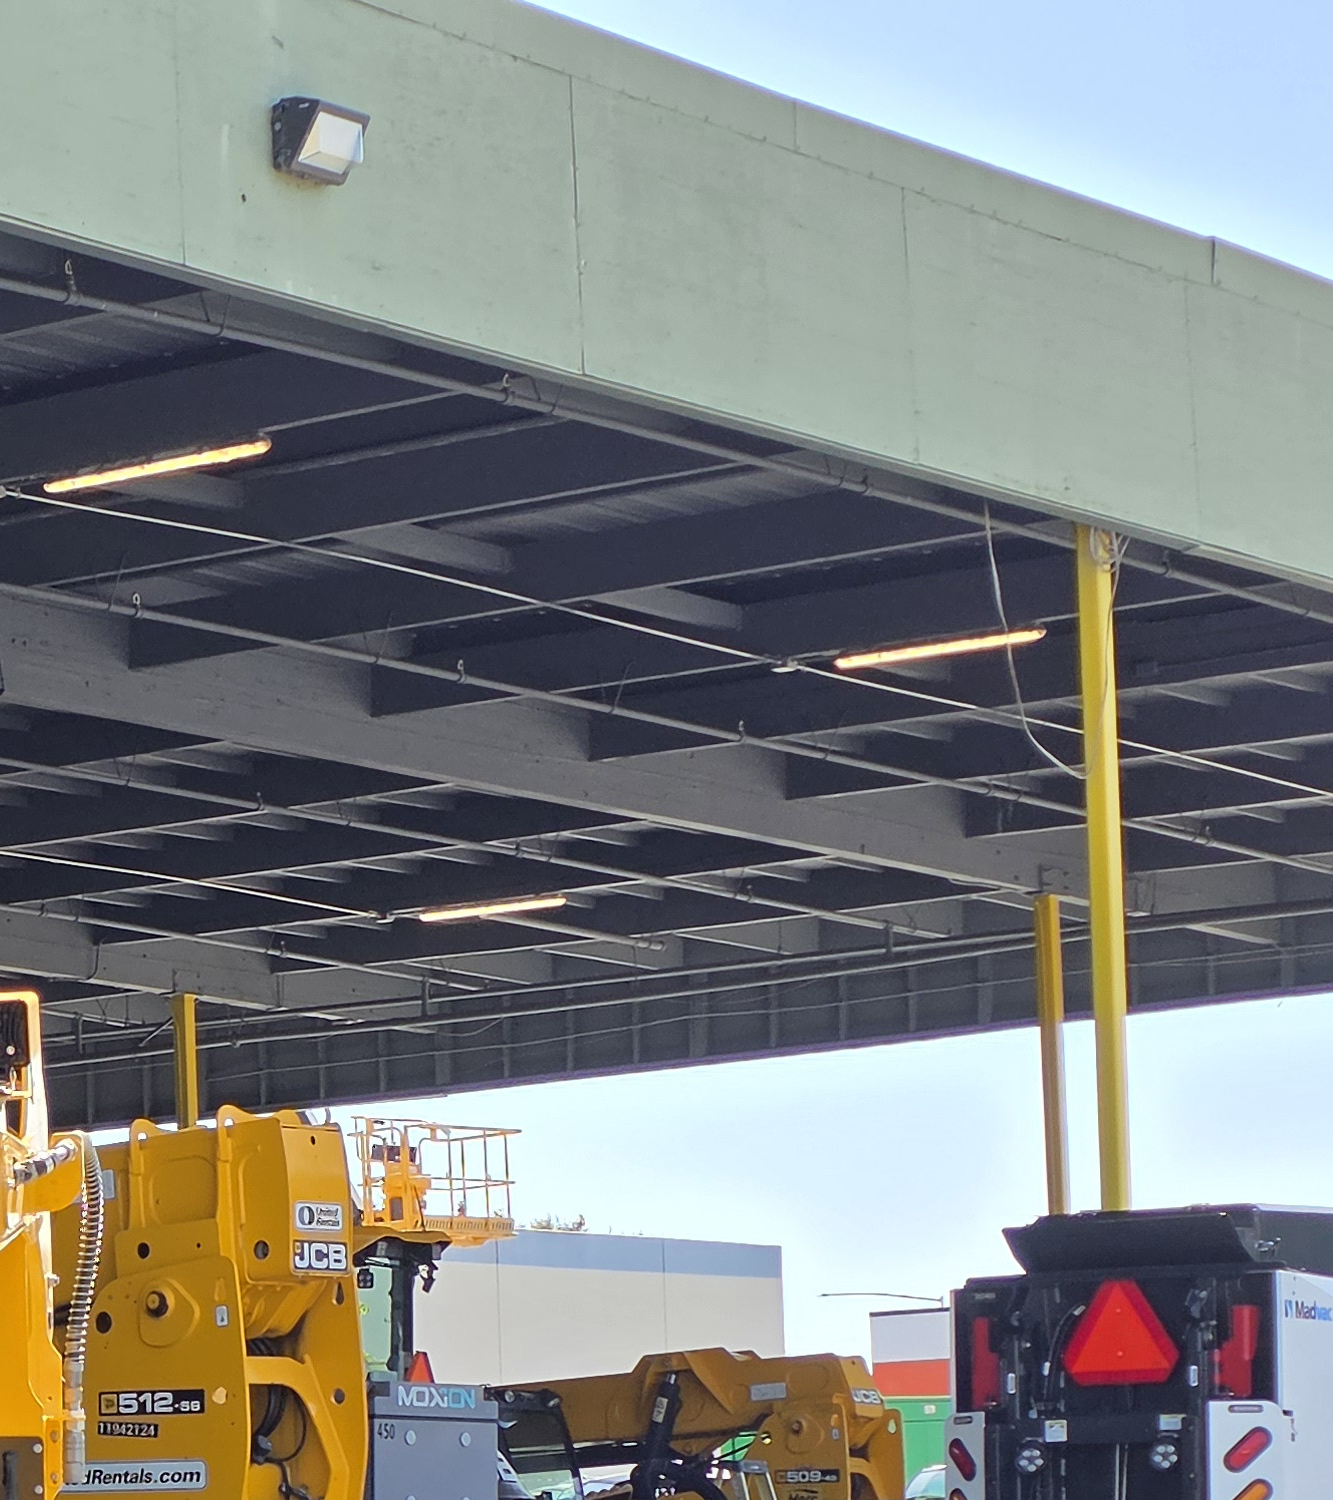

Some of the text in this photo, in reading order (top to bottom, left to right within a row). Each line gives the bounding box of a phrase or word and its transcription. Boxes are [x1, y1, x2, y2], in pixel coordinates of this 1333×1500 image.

[294, 1242, 347, 1270] JCB
[397, 1385, 476, 1409] MOXION
[376, 1423, 396, 1440] 450
